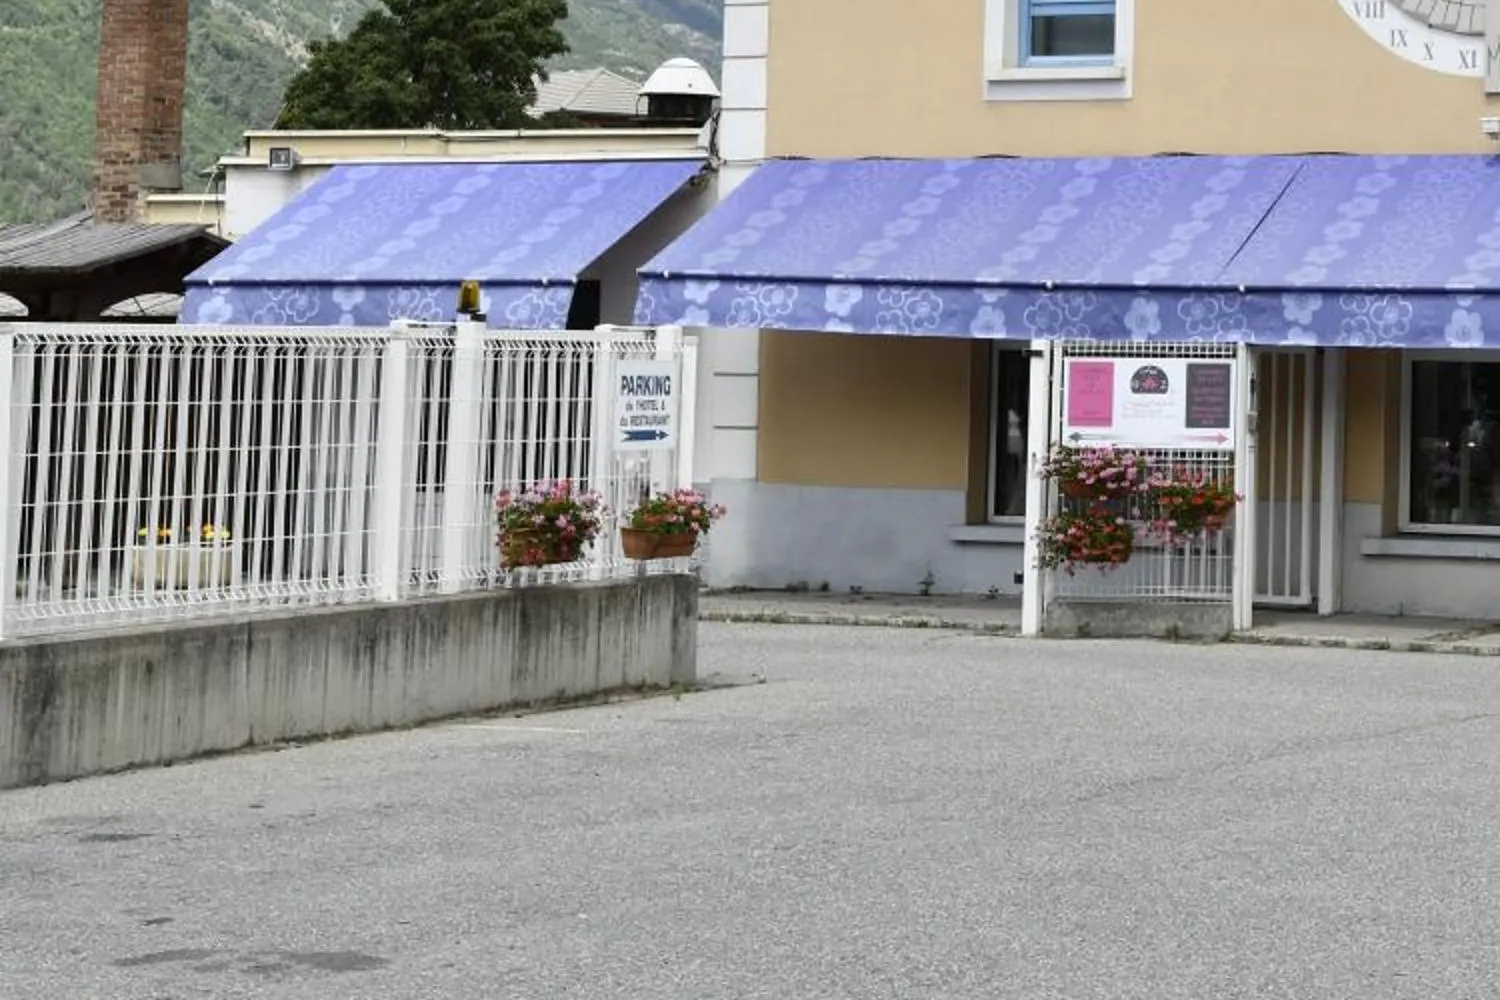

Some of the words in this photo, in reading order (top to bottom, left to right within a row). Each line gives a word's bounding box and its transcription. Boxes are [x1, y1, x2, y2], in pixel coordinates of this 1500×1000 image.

[1353, 0, 1386, 19] VIII
[1391, 29, 1408, 47] IX
[1423, 42, 1434, 60] X
[1459, 49, 1478, 68] XI
[621, 375, 671, 396] PARKING
